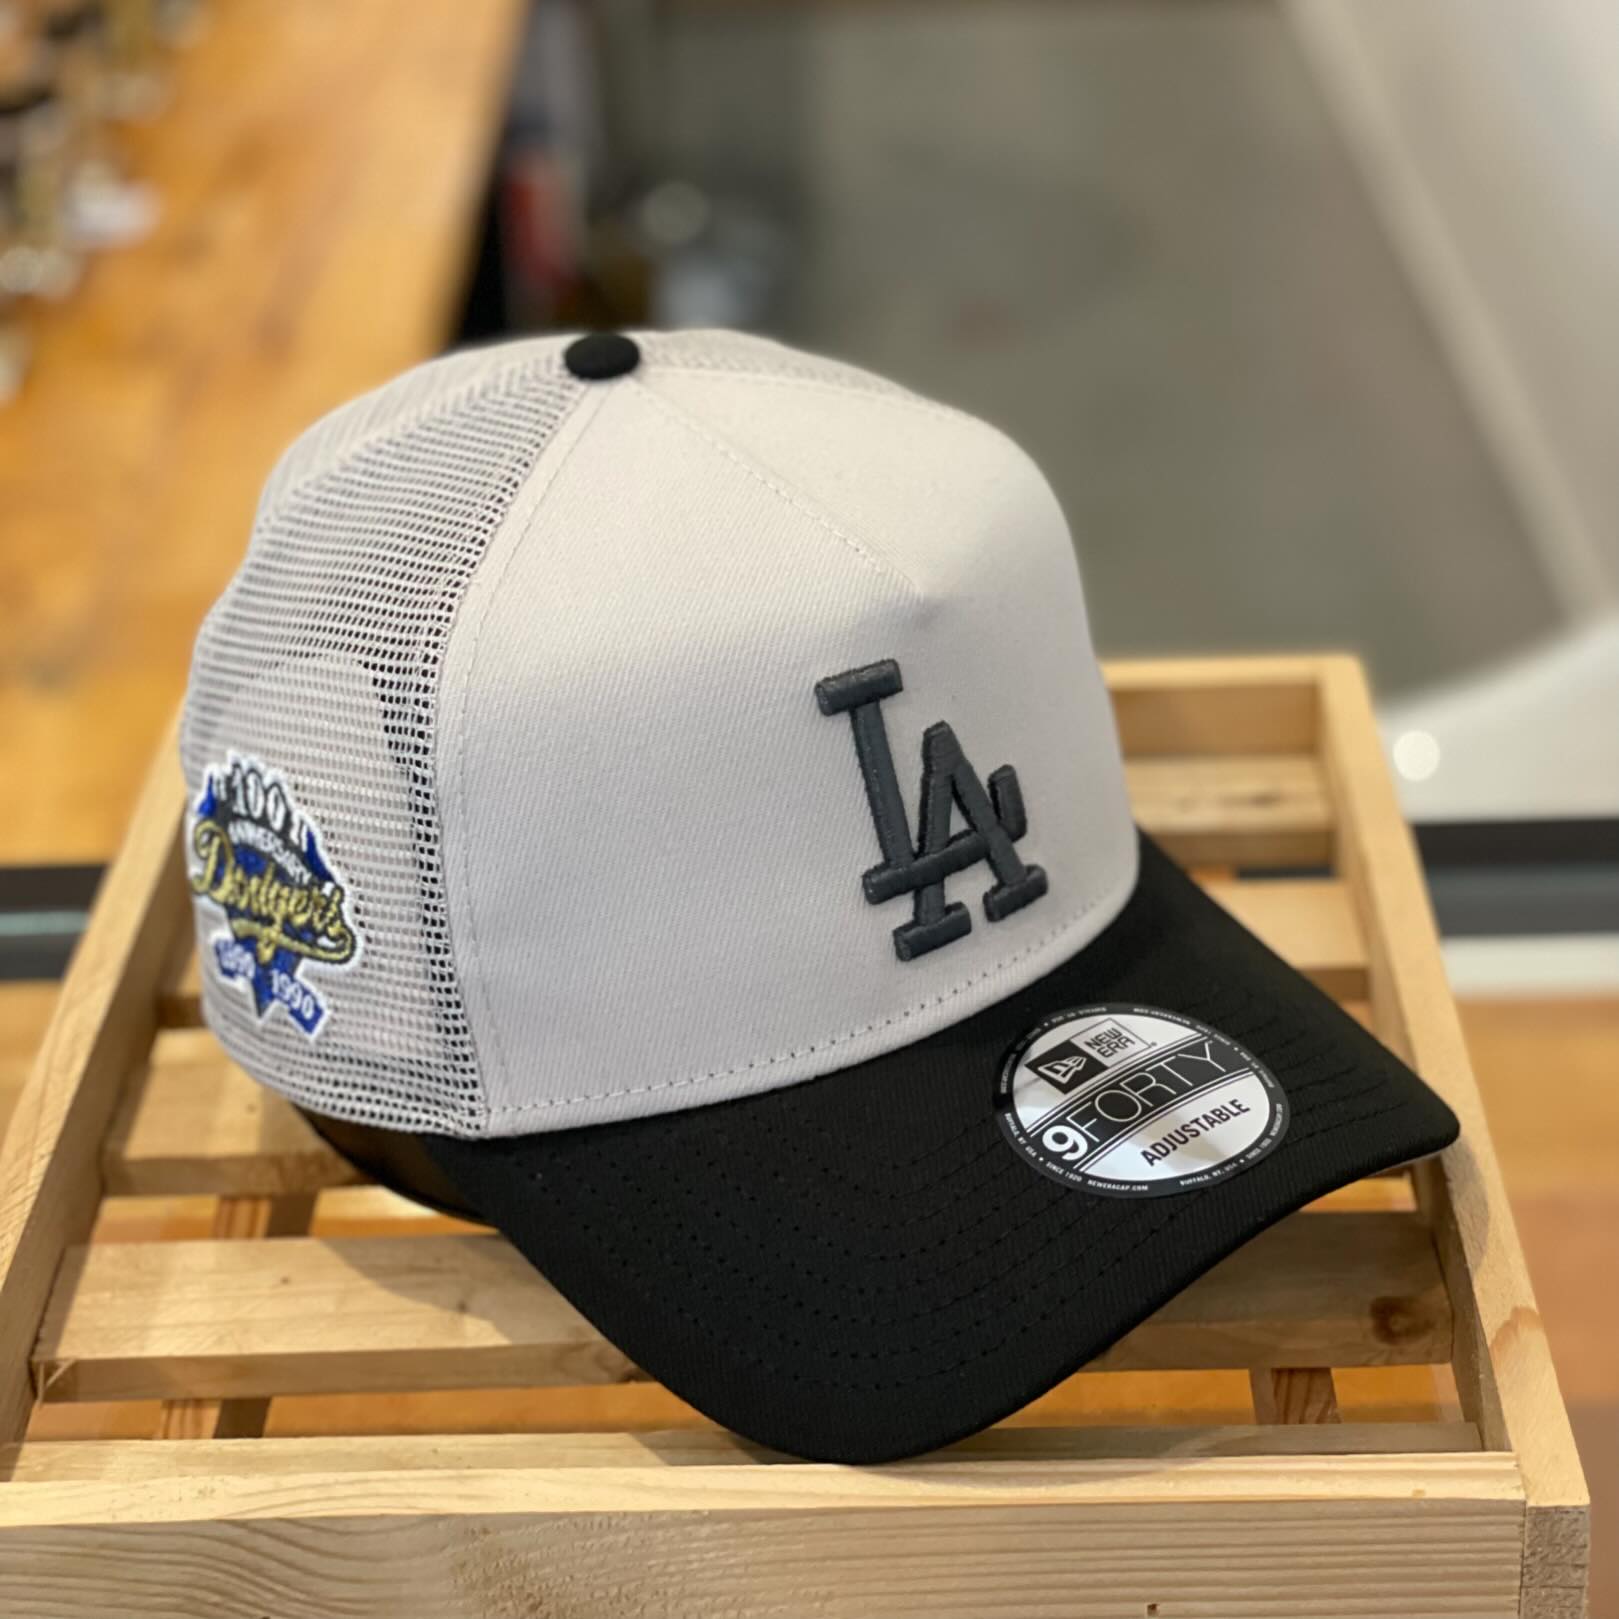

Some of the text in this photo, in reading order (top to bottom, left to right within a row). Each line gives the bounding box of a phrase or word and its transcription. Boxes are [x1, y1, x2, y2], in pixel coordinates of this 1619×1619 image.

[814, 658, 1048, 962] LA
[191, 819, 353, 964] Dodgers
[271, 968, 316, 1021] 1990
[1083, 1027, 1123, 1051] NEW
[1095, 1037, 1137, 1059] ERA
[1041, 1041, 1227, 1161] 9FORTY
[1140, 1098, 1251, 1167] ADJUSTABLE
